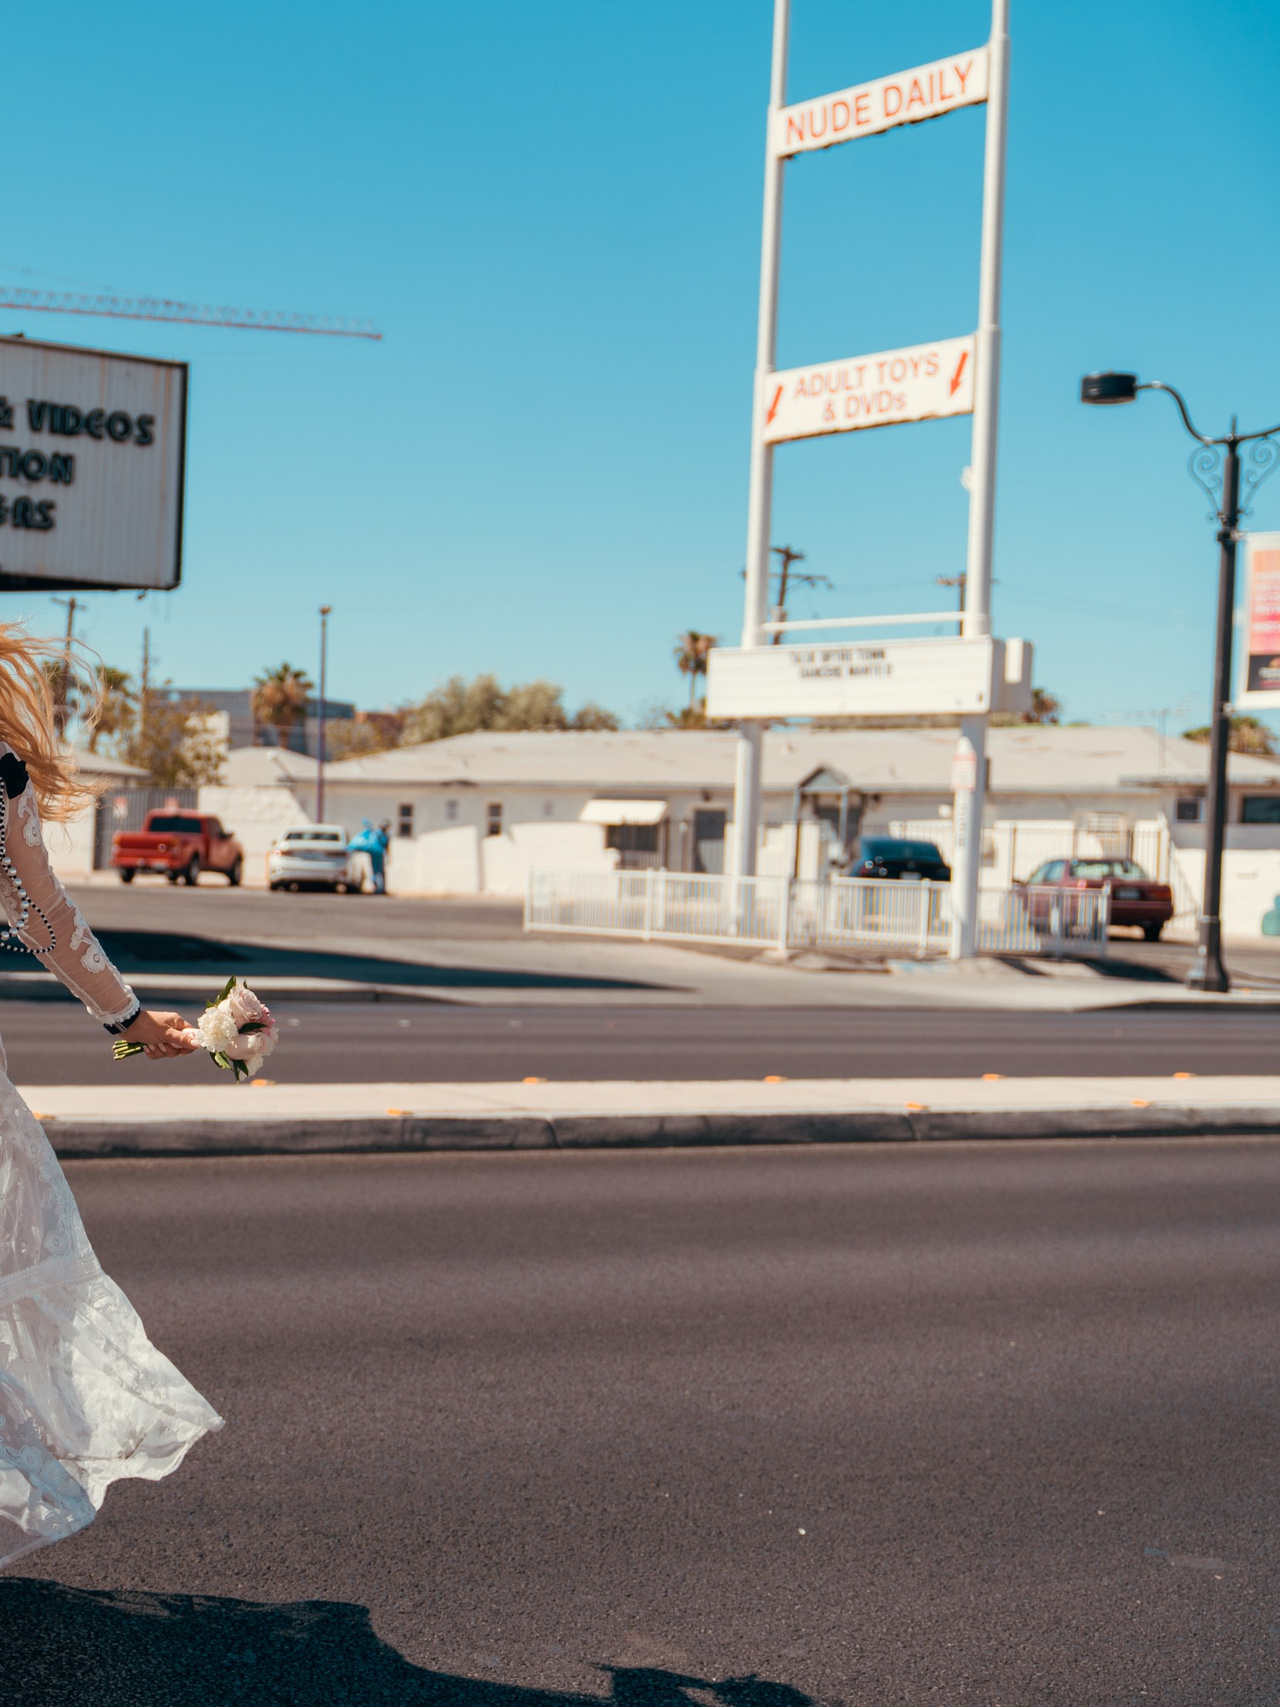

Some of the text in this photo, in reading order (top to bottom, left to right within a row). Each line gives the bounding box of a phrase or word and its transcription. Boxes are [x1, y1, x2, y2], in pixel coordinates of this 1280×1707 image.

[785, 60, 974, 147] NUDE DAILY
[793, 352, 940, 401] ADULT TOYS
[26, 398, 156, 446] VIDEOS
[823, 394, 907, 423] & DVDs
